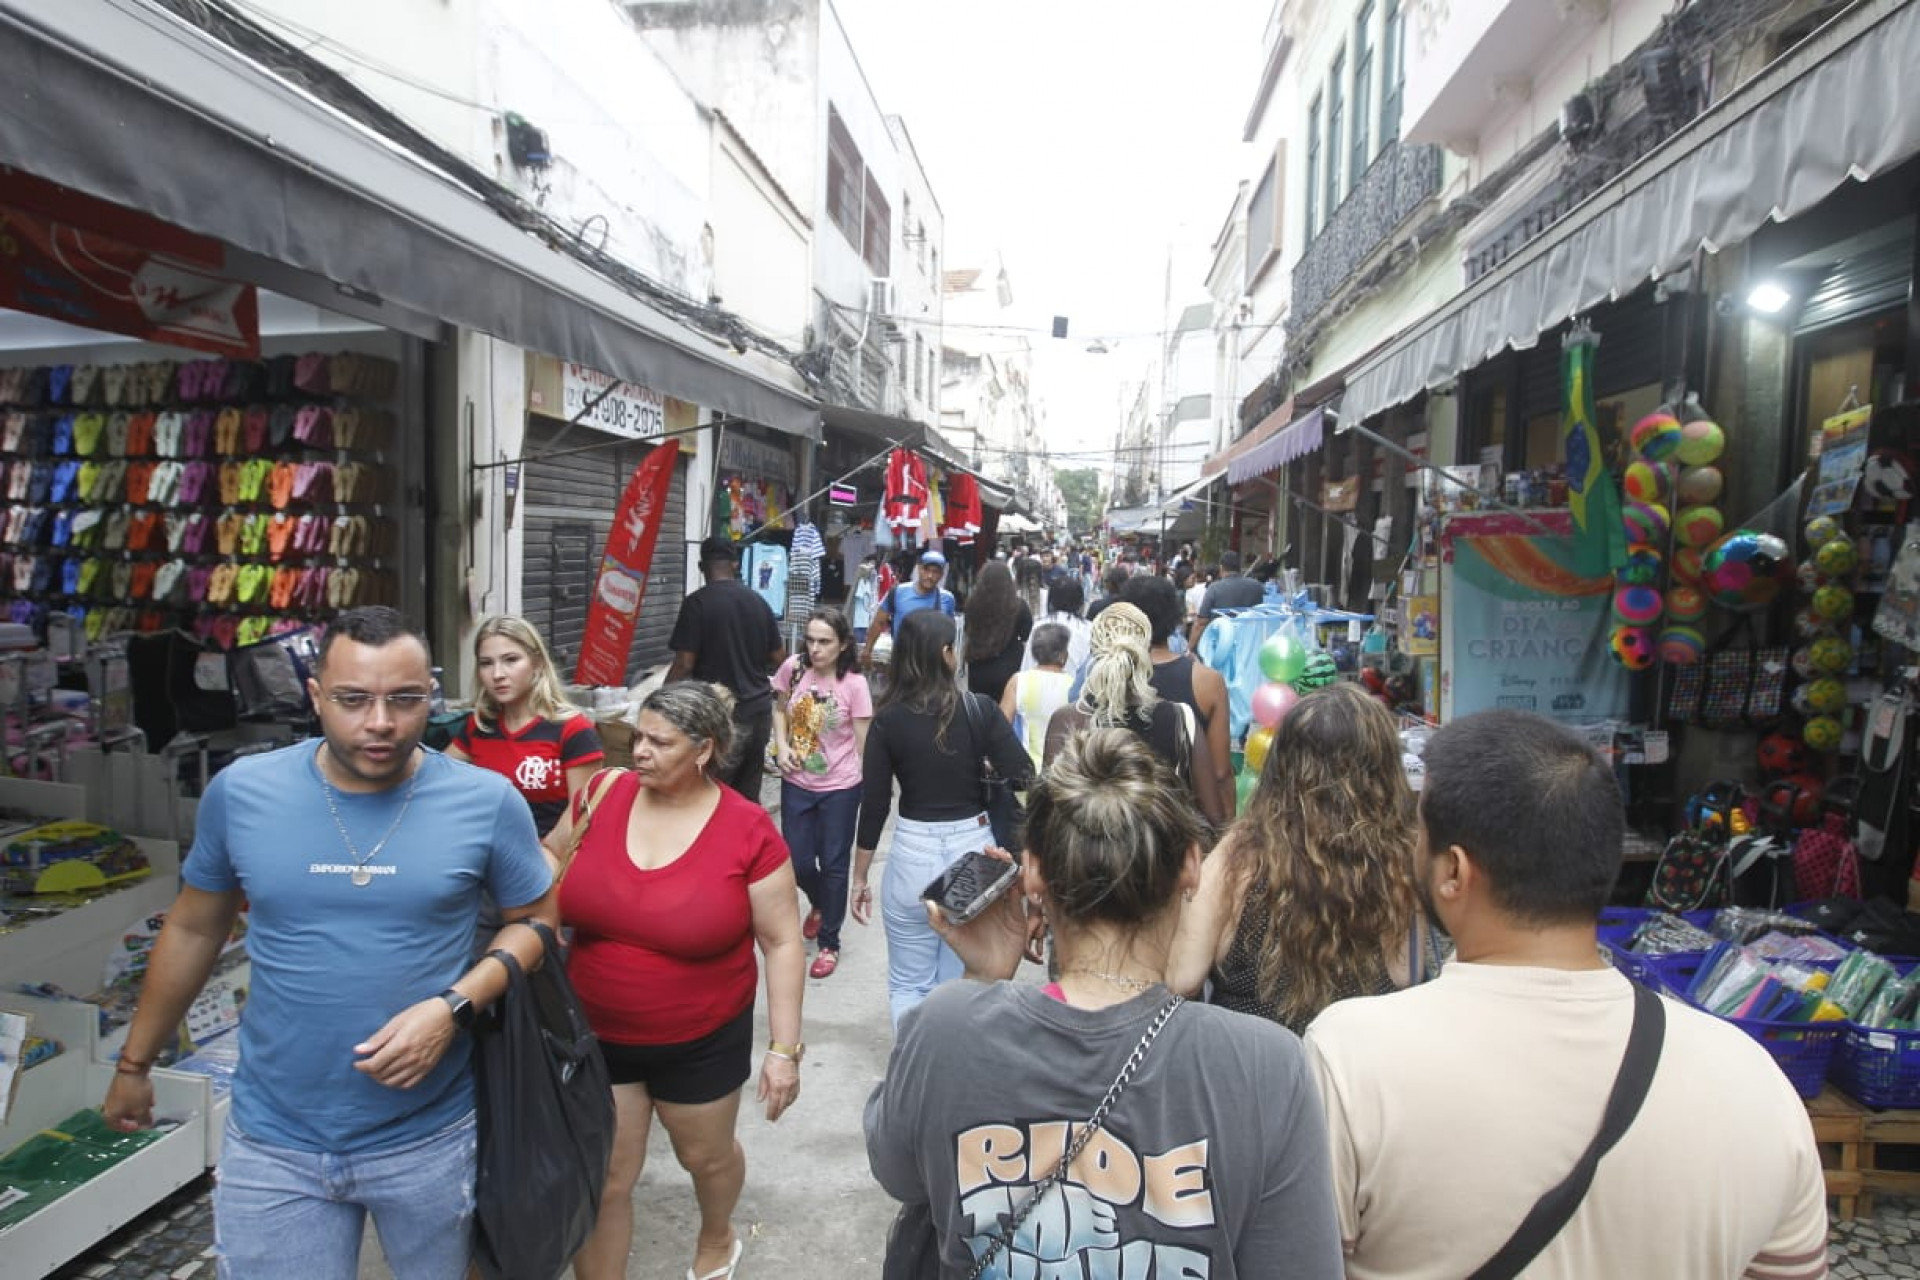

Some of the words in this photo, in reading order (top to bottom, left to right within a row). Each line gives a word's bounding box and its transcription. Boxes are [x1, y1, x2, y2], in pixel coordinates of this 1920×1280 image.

[1503, 616, 1551, 633] DIA
[1468, 639, 1583, 661] CRIANÇ
[956, 1120, 1215, 1228] RIDE
[960, 1183, 1120, 1261] THE
